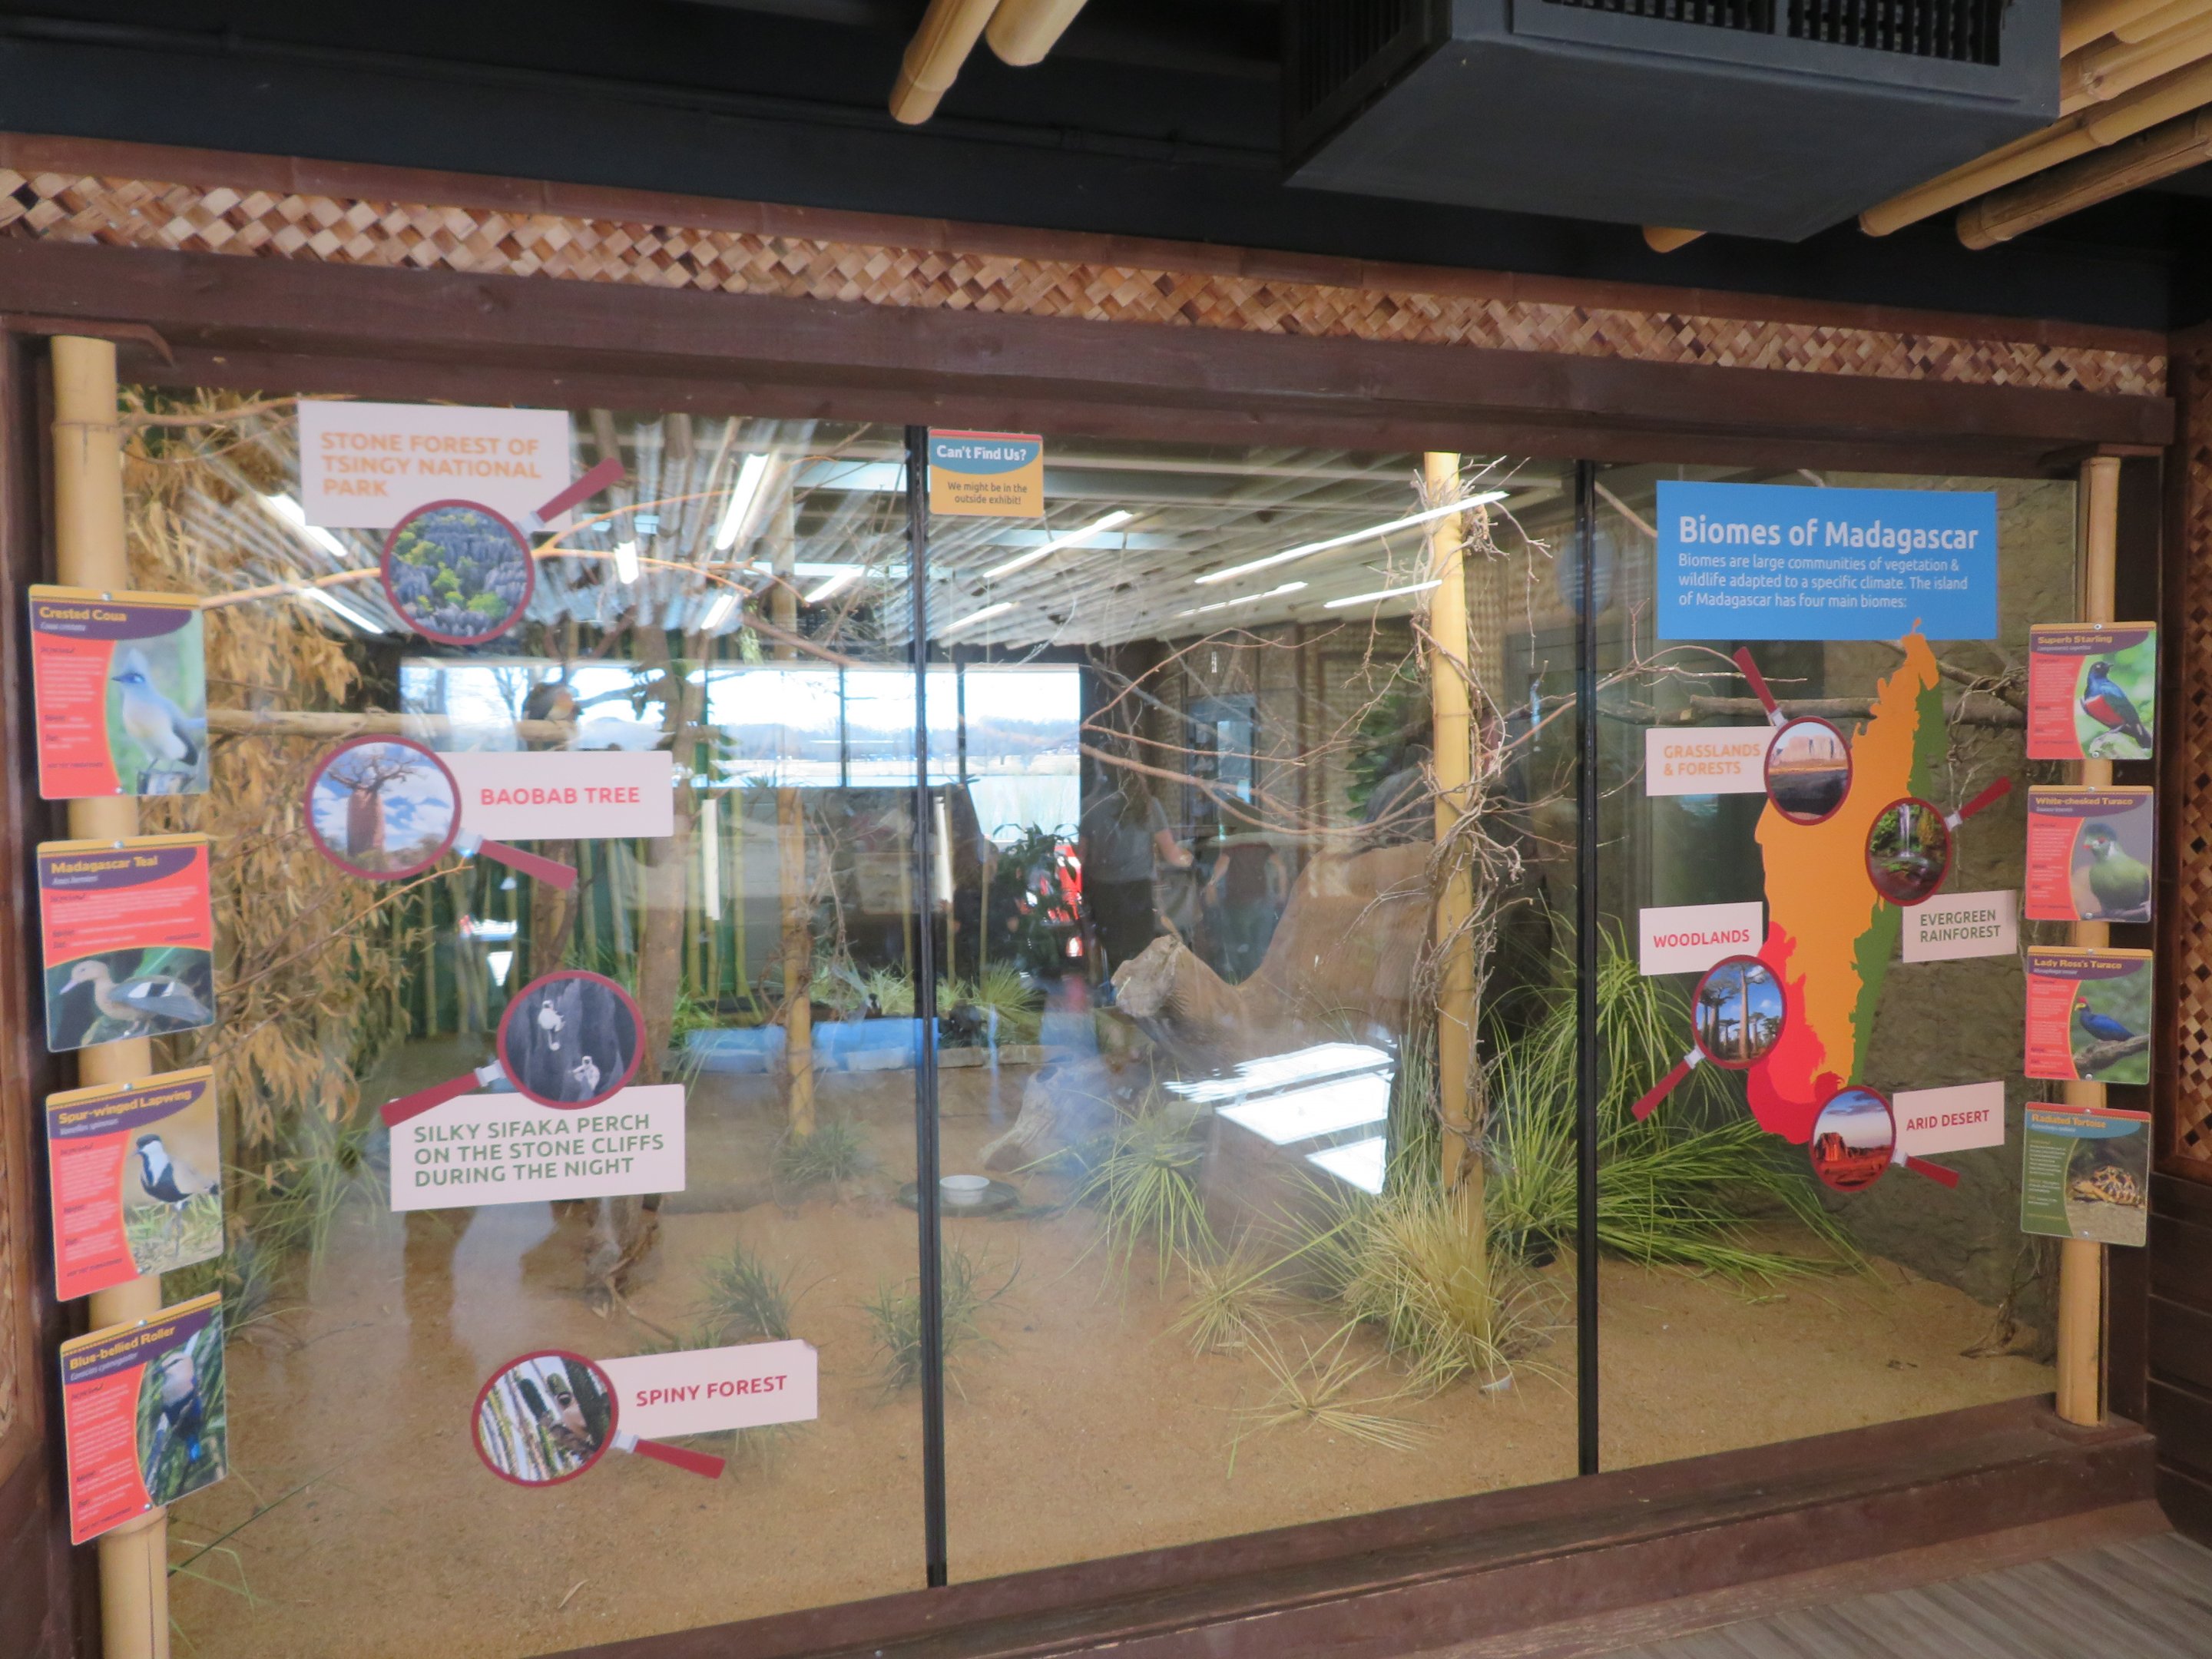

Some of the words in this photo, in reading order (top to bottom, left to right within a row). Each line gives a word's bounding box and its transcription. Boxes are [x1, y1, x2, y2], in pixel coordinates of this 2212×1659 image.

[320, 432, 402, 452] STONE
[410, 435, 501, 454] FOREST
[508, 439, 539, 455] OF
[936, 445, 971, 459] Can't
[974, 446, 1001, 460] Find
[1004, 449, 1027, 461] Us?
[321, 455, 410, 475] TSINGY
[418, 459, 541, 478] NATIONAL
[323, 478, 388, 497] PARK
[948, 482, 962, 490] We
[964, 482, 988, 492] might
[991, 483, 1001, 492] be
[1003, 484, 1012, 492] in
[1013, 484, 1028, 493] the
[955, 495, 987, 504] outside
[988, 495, 1022, 505] exhibit!
[1679, 515, 1780, 545] Biomes
[1789, 518, 1818, 546] of
[1825, 520, 1979, 555] Madagascar
[1678, 553, 1727, 568] Biomes
[1730, 557, 1750, 569] are
[1753, 555, 1784, 571] large
[1788, 556, 1866, 571] communities
[1869, 557, 1883, 571] of
[1884, 558, 1948, 574] vegetation
[1951, 559, 1959, 571] &
[1678, 573, 1727, 587] wildlife
[1730, 574, 1781, 590] adapted
[1785, 576, 1798, 588] to
[1801, 578, 1809, 588] a
[1811, 575, 1857, 591] specific
[1860, 575, 1906, 590] climate.
[1909, 576, 1931, 590] The
[1934, 576, 1968, 590] island
[1678, 591, 1694, 606] of
[1696, 591, 1770, 609] Madagascar
[1775, 594, 1796, 608] has
[1799, 594, 1826, 608] four
[1829, 594, 1857, 608] main
[1860, 594, 1907, 608] biomes:
[1664, 743, 1760, 759] GRASSLANDS
[1663, 763, 1673, 776] &
[1678, 761, 1742, 775] FORESTS
[481, 787, 578, 805] BAOBAB
[584, 786, 641, 803] TREE
[51, 859, 131, 874] Madagascar
[1920, 909, 1996, 926] EVERGREEN
[1653, 929, 1750, 948] WOODLANDS
[1920, 925, 2001, 942] RAINFOREST
[414, 1123, 481, 1143] SILKY
[488, 1119, 570, 1139] SIFAKA
[577, 1114, 650, 1133] PERCH
[1906, 1116, 1938, 1131] ARID
[1942, 1109, 1989, 1127] DESERT
[414, 1147, 449, 1164] ON
[457, 1144, 502, 1162] THE
[509, 1138, 584, 1159] STONE
[591, 1134, 664, 1154] CLIFFS
[415, 1165, 505, 1187] DURING
[512, 1161, 558, 1181] THE
[565, 1157, 634, 1177] NIGHT
[69, 1336, 139, 1370] Blue-bellied
[141, 1326, 176, 1345] Roller
[636, 1385, 700, 1407] SPINY
[707, 1375, 788, 1399] FOREST
